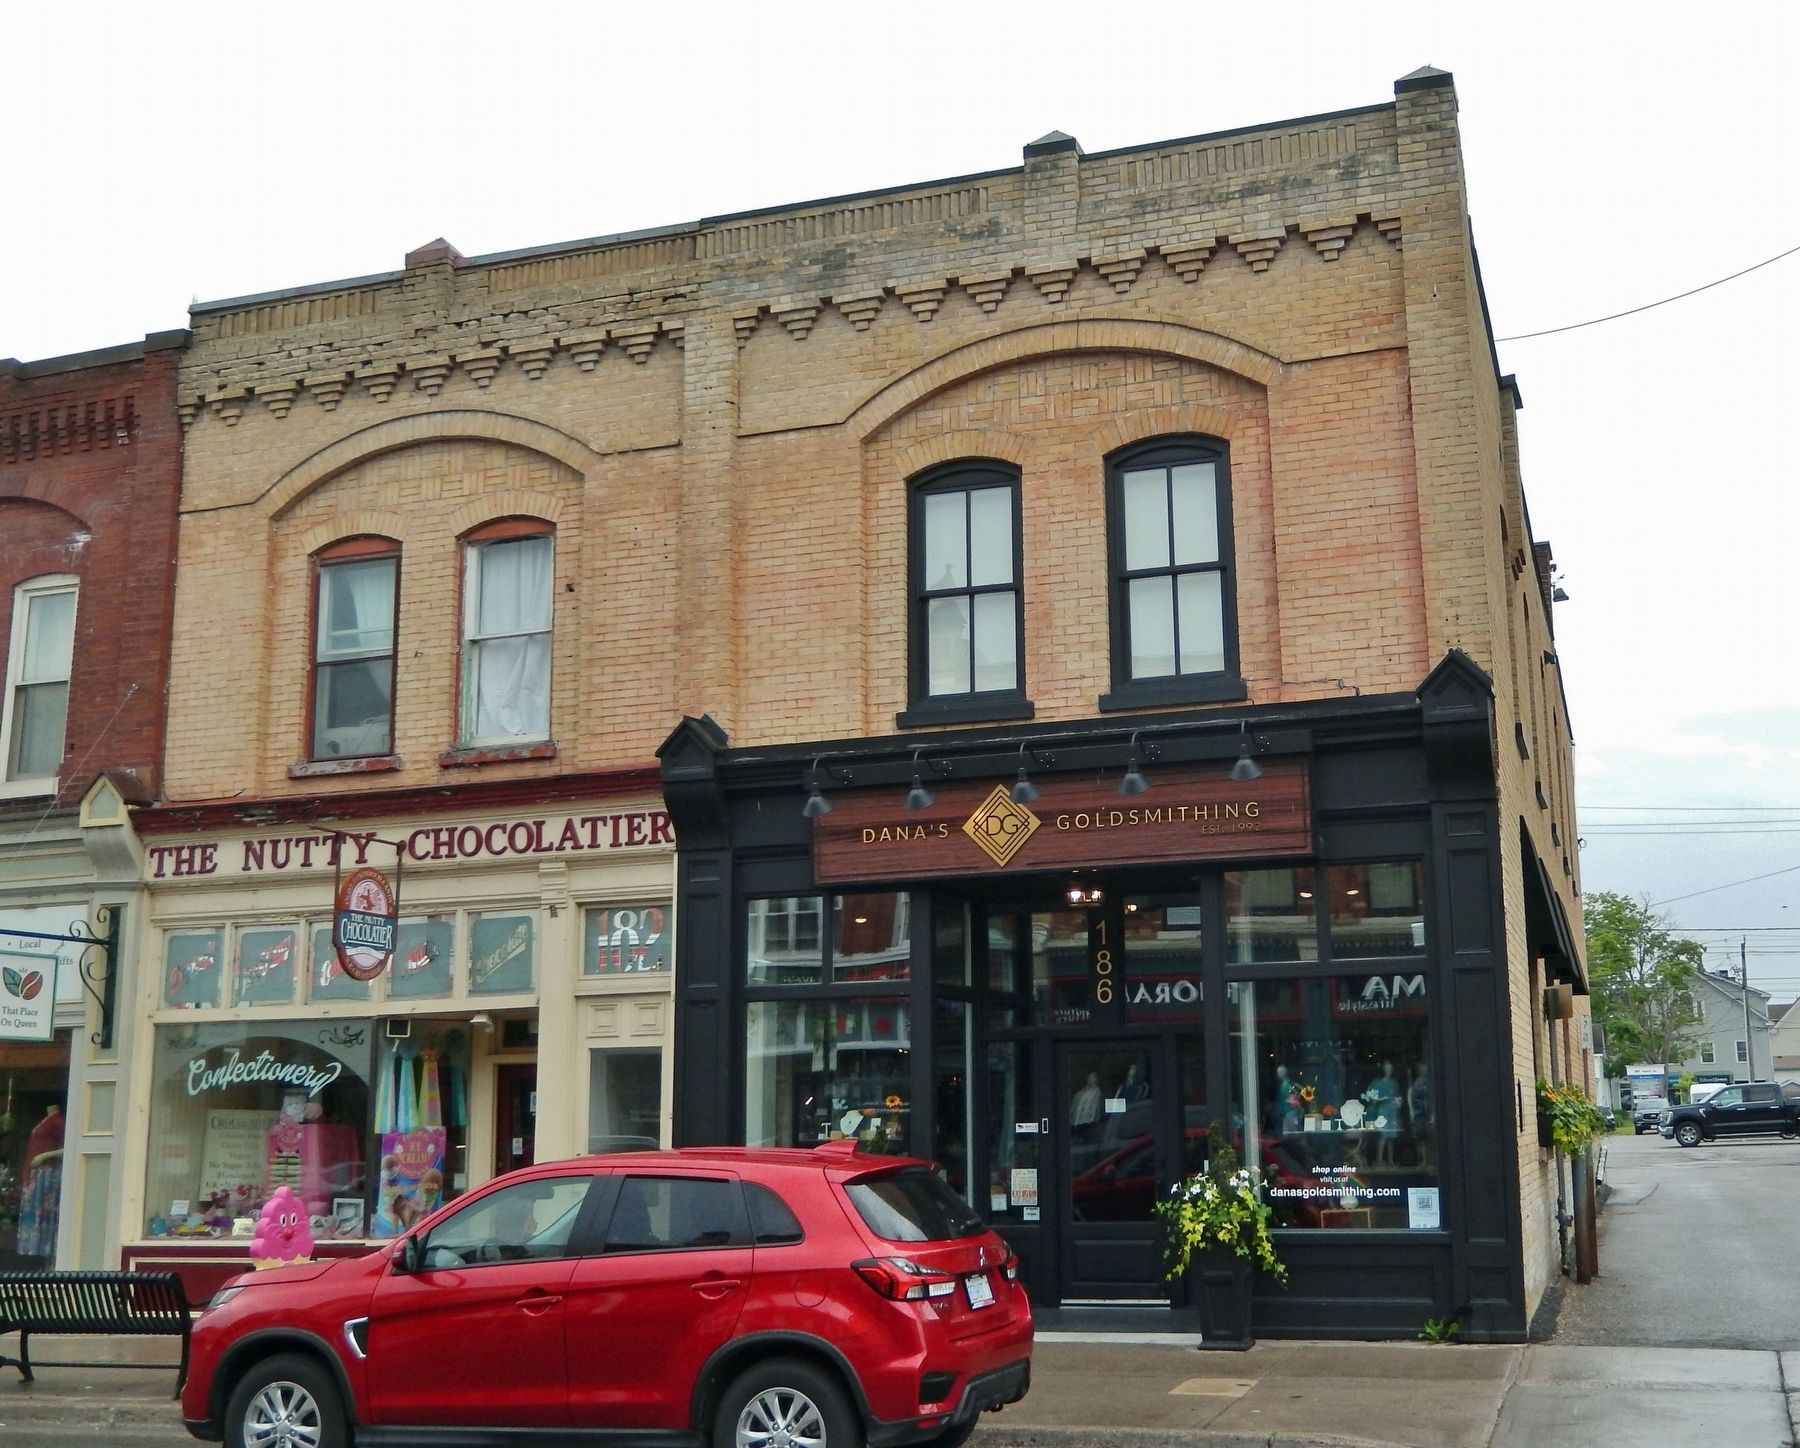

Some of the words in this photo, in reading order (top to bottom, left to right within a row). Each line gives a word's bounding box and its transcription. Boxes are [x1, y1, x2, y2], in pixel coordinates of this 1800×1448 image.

[862, 823, 949, 844] DANA'S
[1056, 801, 1260, 830] GOLDSMITHING
[985, 813, 1019, 836] DG
[1201, 825, 1225, 835] EST.
[1231, 822, 1262, 833] 1992
[149, 843, 219, 878] THE
[242, 832, 377, 871] NUTTY
[407, 811, 675, 861] CHOCOLATIER
[350, 913, 364, 923] THE
[365, 915, 386, 926] NUTTY
[341, 918, 393, 950] CHOCOLATIER
[19, 939, 41, 949] Local
[58, 955, 74, 965] ifts
[1095, 919, 1113, 1004] 186
[2, 1006, 18, 1015] That
[20, 1006, 39, 1016] Place
[1, 1018, 13, 1026] On
[14, 1018, 38, 1028] Queen
[187, 1049, 342, 1098] Confectionery
[1312, 1165, 1331, 1175] shop
[1333, 1164, 1357, 1173] online
[1270, 1186, 1401, 1199] danasgoldsmithing.com
